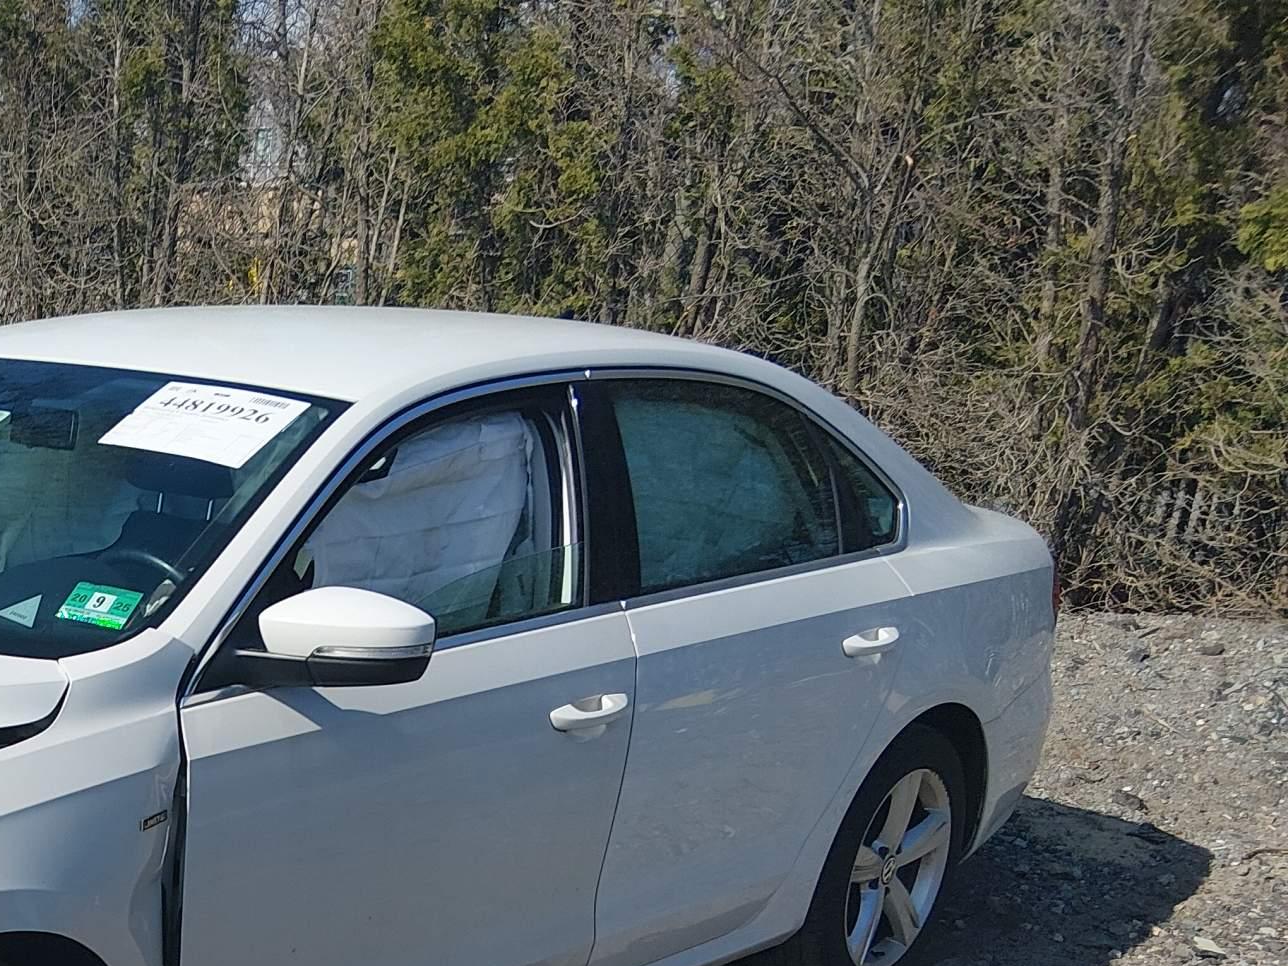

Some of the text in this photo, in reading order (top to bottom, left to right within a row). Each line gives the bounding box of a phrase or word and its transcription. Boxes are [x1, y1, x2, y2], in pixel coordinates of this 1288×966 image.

[159, 396, 270, 425] 44819926
[72, 592, 88, 603] 20
[93, 596, 106, 609] 9
